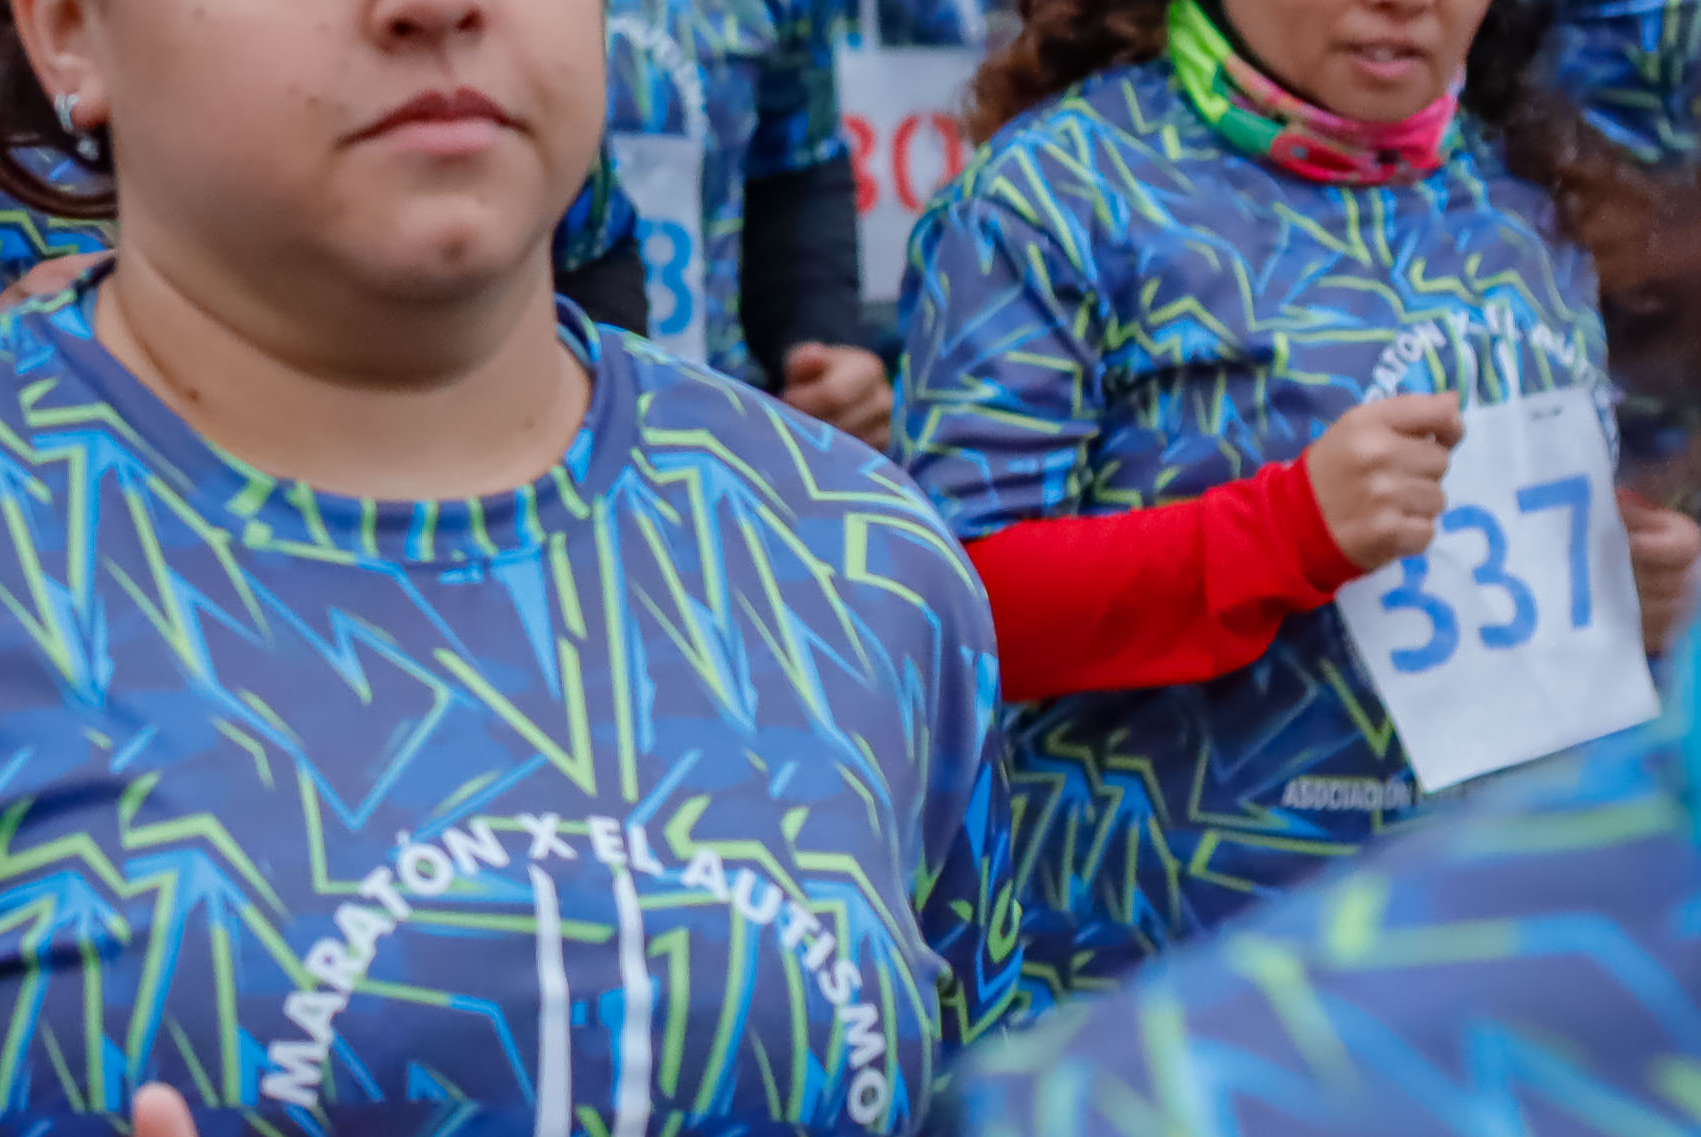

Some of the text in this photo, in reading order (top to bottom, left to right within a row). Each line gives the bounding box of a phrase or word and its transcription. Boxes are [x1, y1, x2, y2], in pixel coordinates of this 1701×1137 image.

[1380, 474, 1592, 674] 337
[262, 811, 889, 1127] MARATÓN X EL AUTISMO
